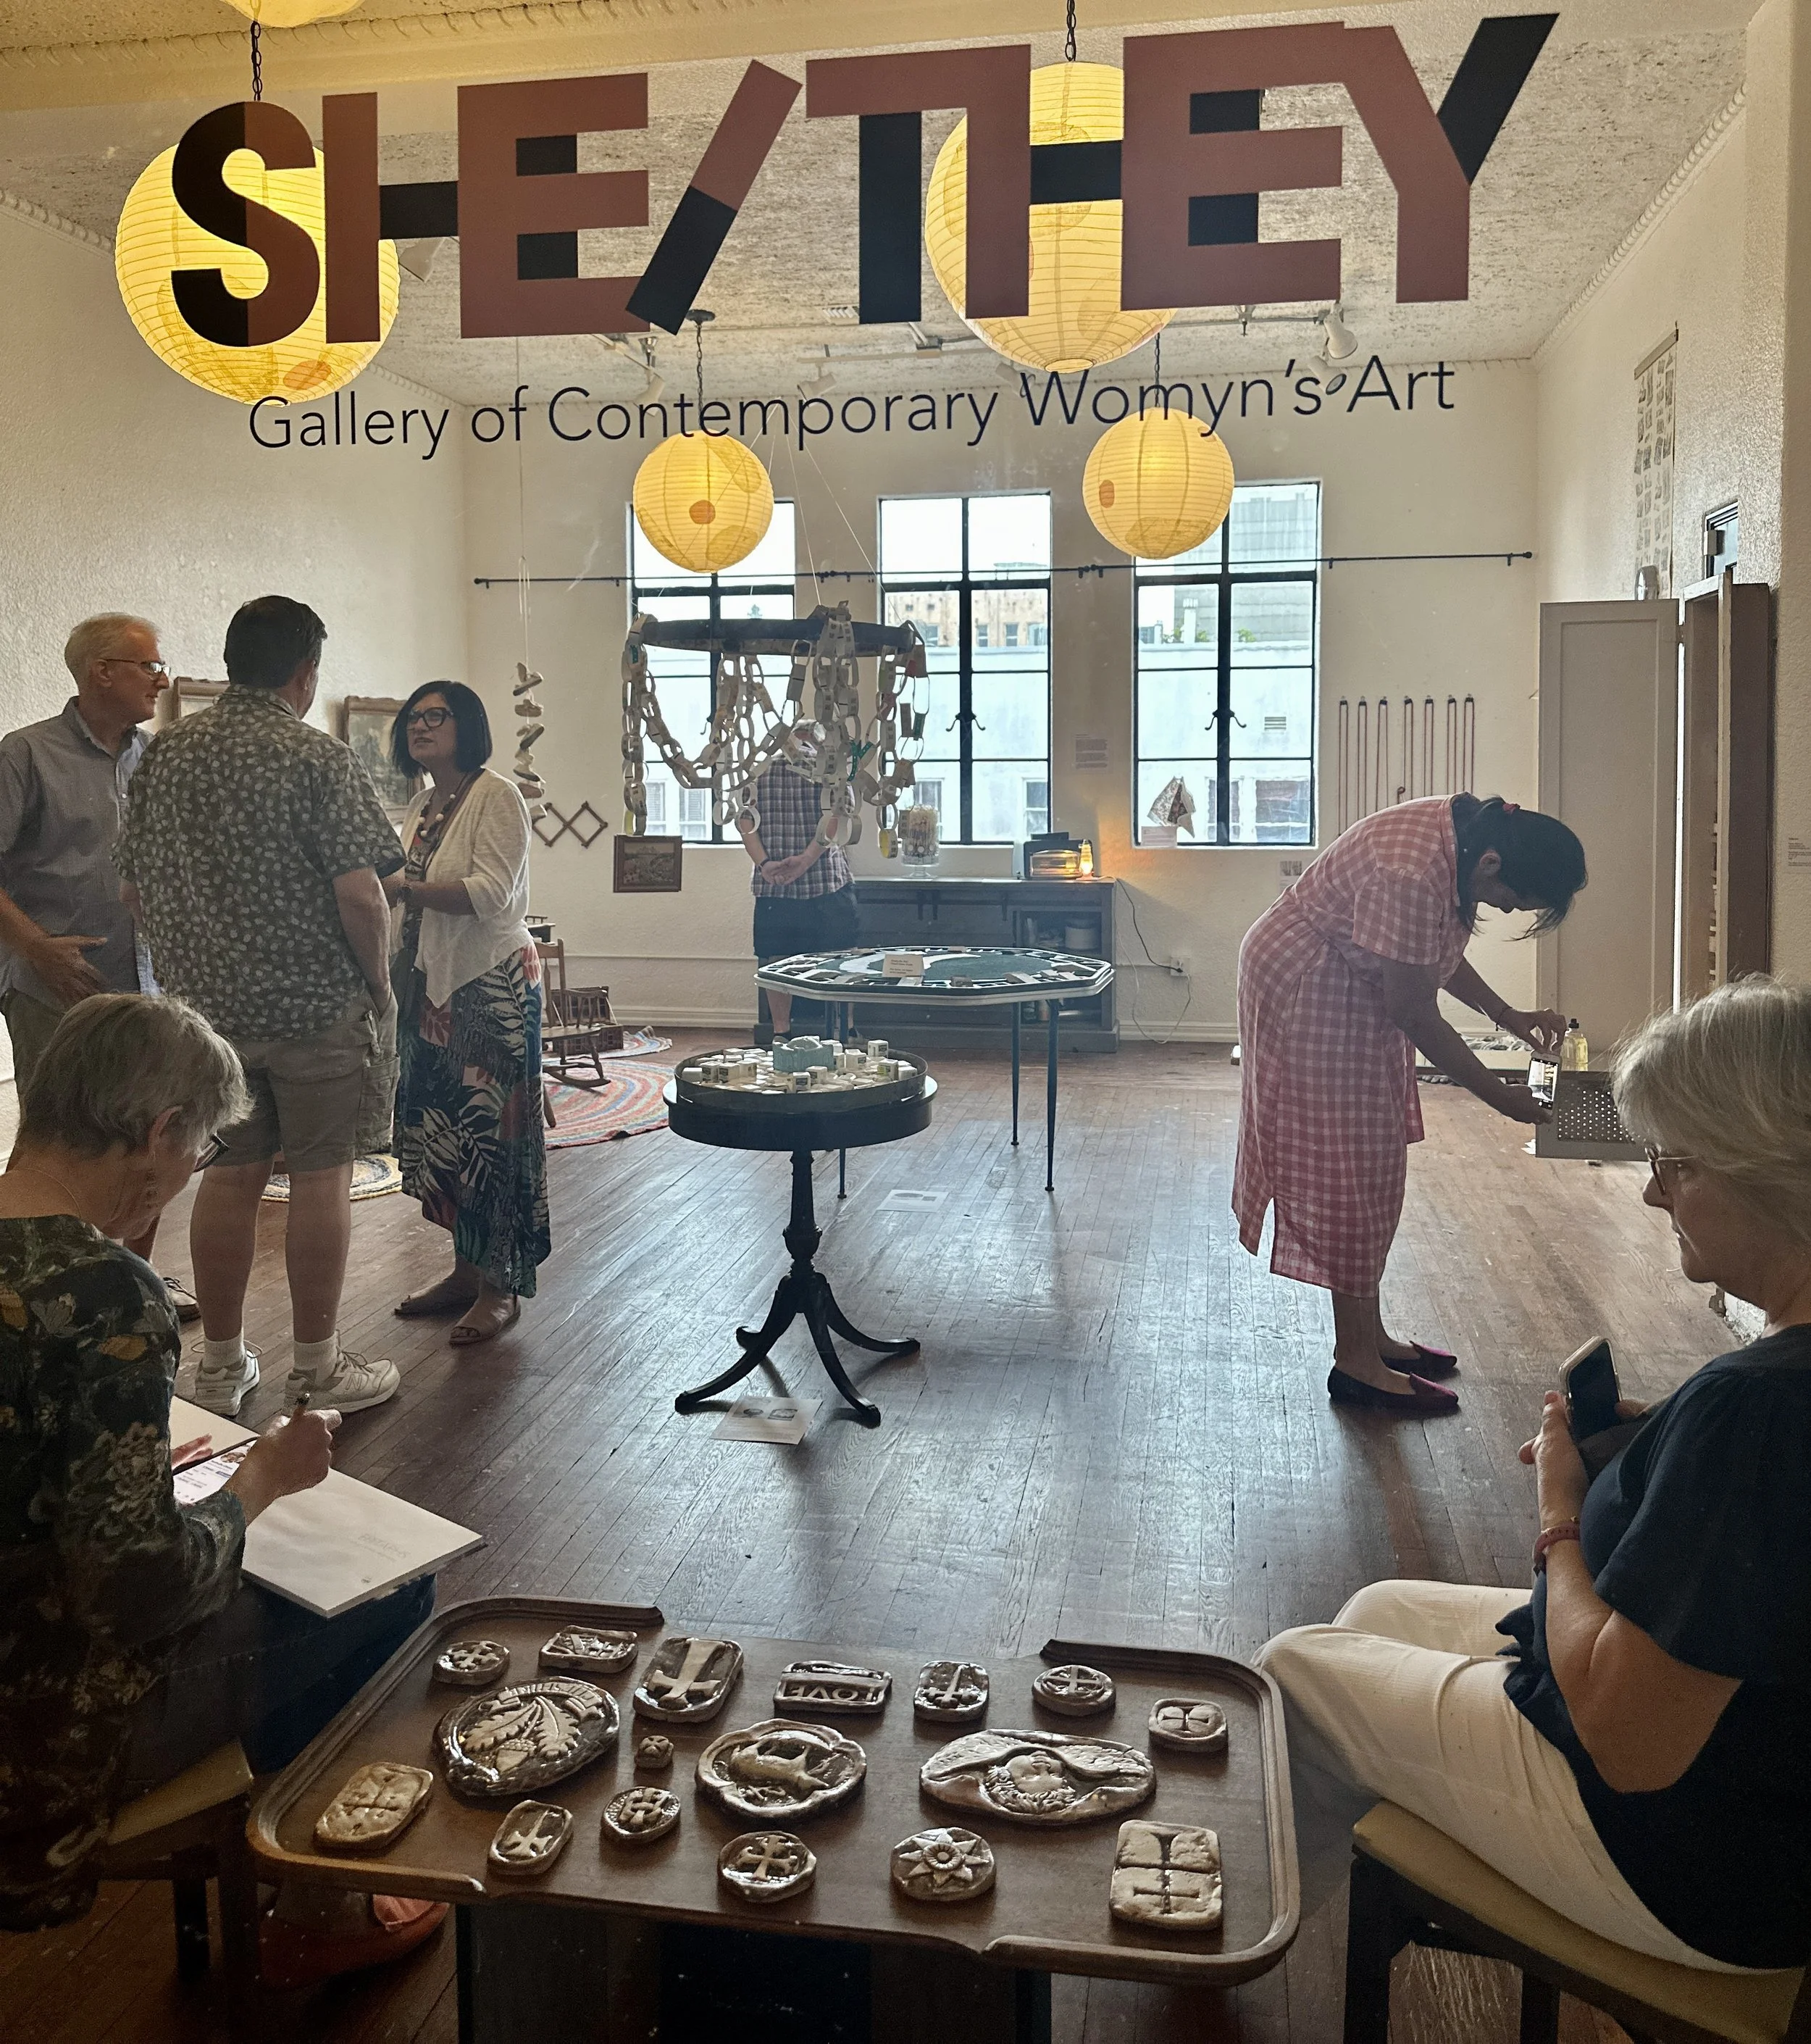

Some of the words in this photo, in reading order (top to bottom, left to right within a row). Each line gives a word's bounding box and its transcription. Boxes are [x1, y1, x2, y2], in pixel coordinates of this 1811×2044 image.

[171, 14, 1559, 347] SHE/THEY
[250, 391, 449, 461] Gallery
[471, 385, 529, 443] of
[548, 385, 998, 451] Contemporary
[1020, 359, 1321, 438] Womyn's
[1347, 355, 1455, 412] Art
